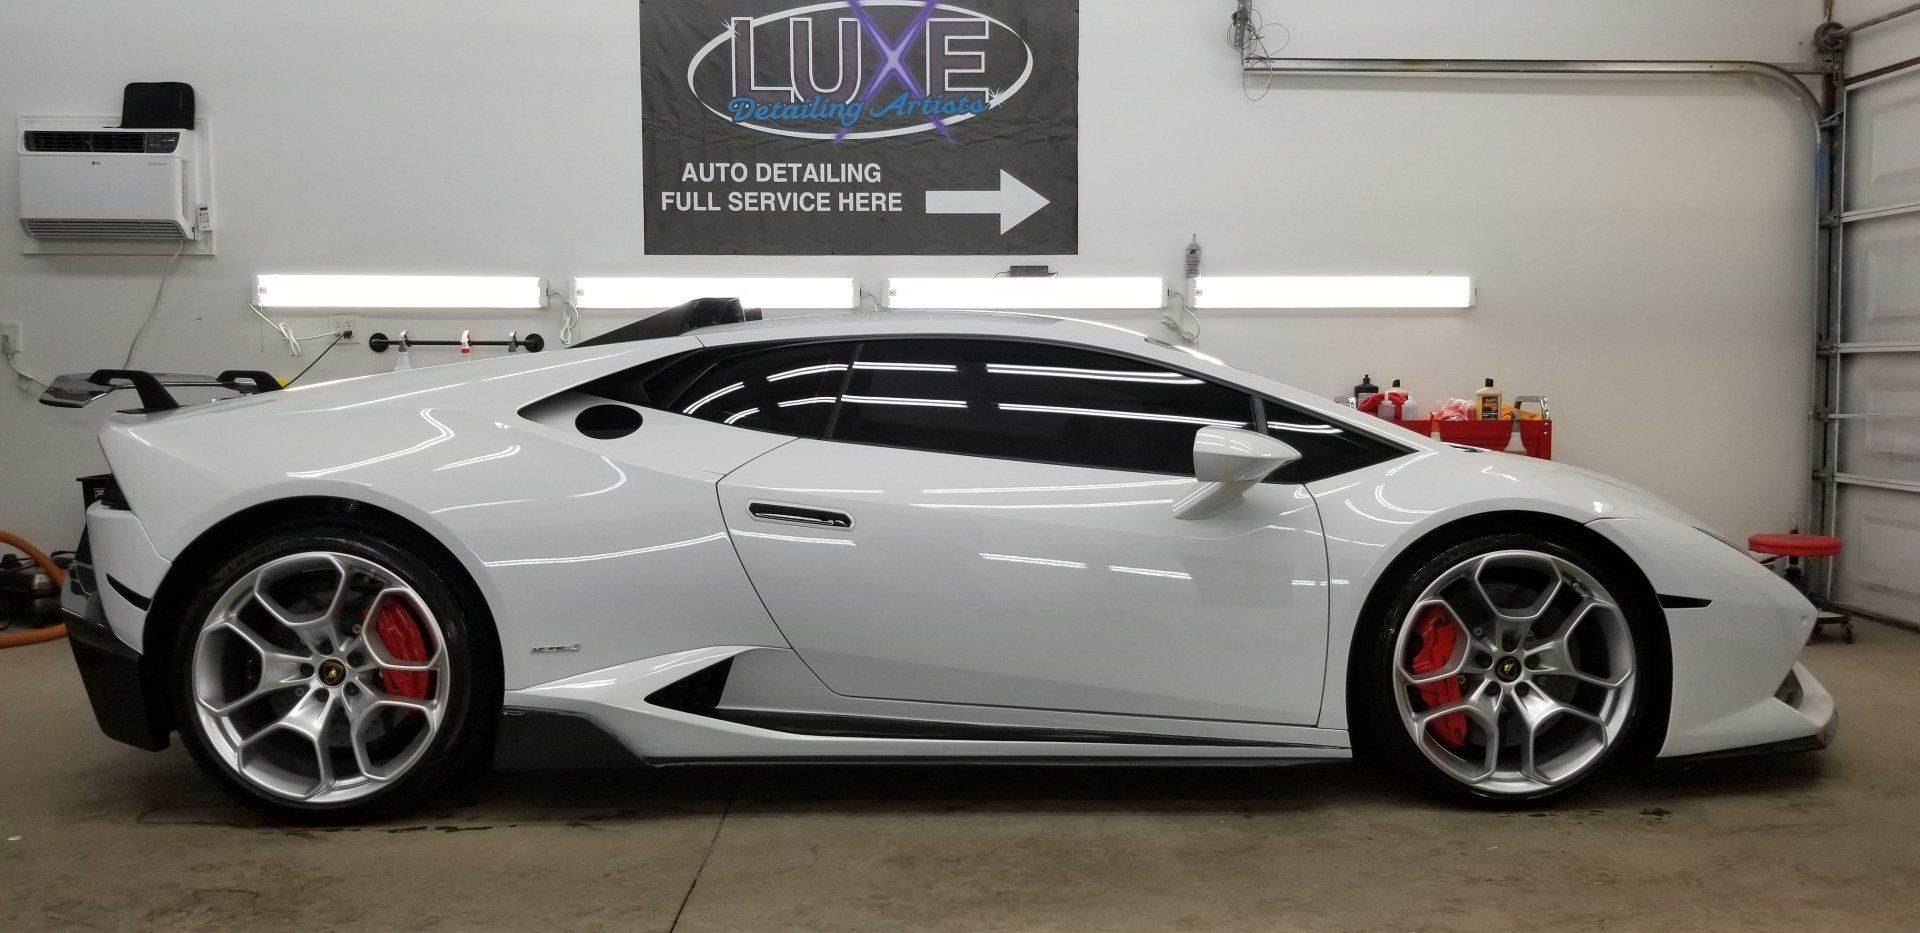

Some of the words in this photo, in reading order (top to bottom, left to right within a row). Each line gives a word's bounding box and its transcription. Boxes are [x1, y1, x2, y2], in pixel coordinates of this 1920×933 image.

[731, 2, 990, 106] LUXE
[728, 93, 862, 127] Detailing
[870, 92, 990, 120] Artists
[682, 163, 747, 182] AUTO
[756, 163, 881, 183] DETAILING
[662, 192, 721, 211] FULL
[729, 192, 830, 211] SERVICE
[839, 193, 902, 211] HERE
